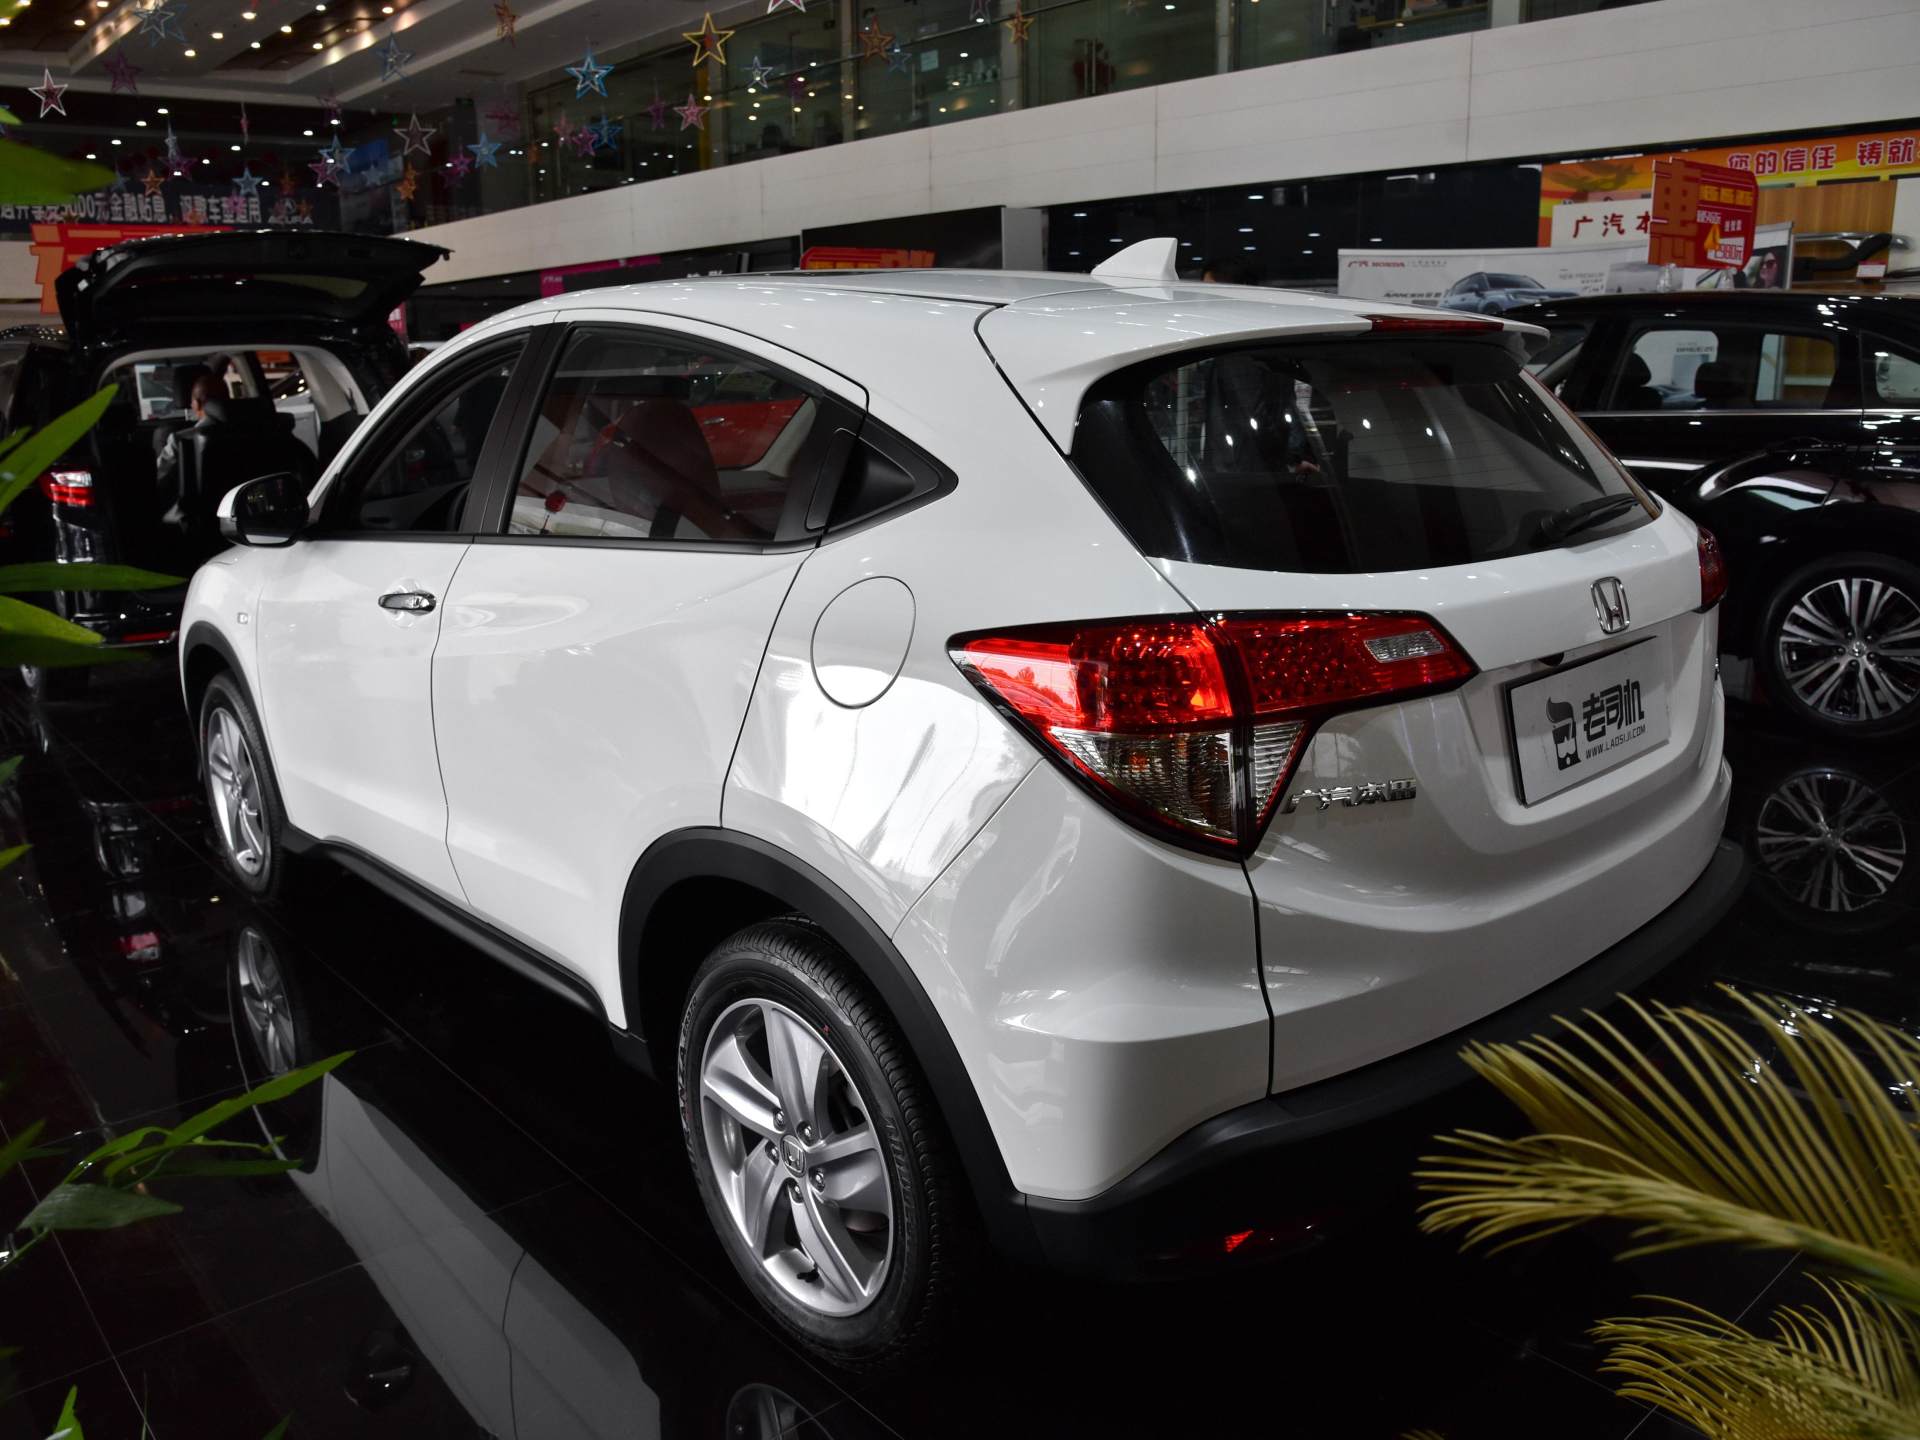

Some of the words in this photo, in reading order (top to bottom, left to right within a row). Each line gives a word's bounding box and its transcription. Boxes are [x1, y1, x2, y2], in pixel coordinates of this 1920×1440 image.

[1857, 137, 1920, 166] 铸就
[1582, 678, 1645, 742] 老司机
[1585, 723, 1646, 760] WWW.LAOSIJI.COM
